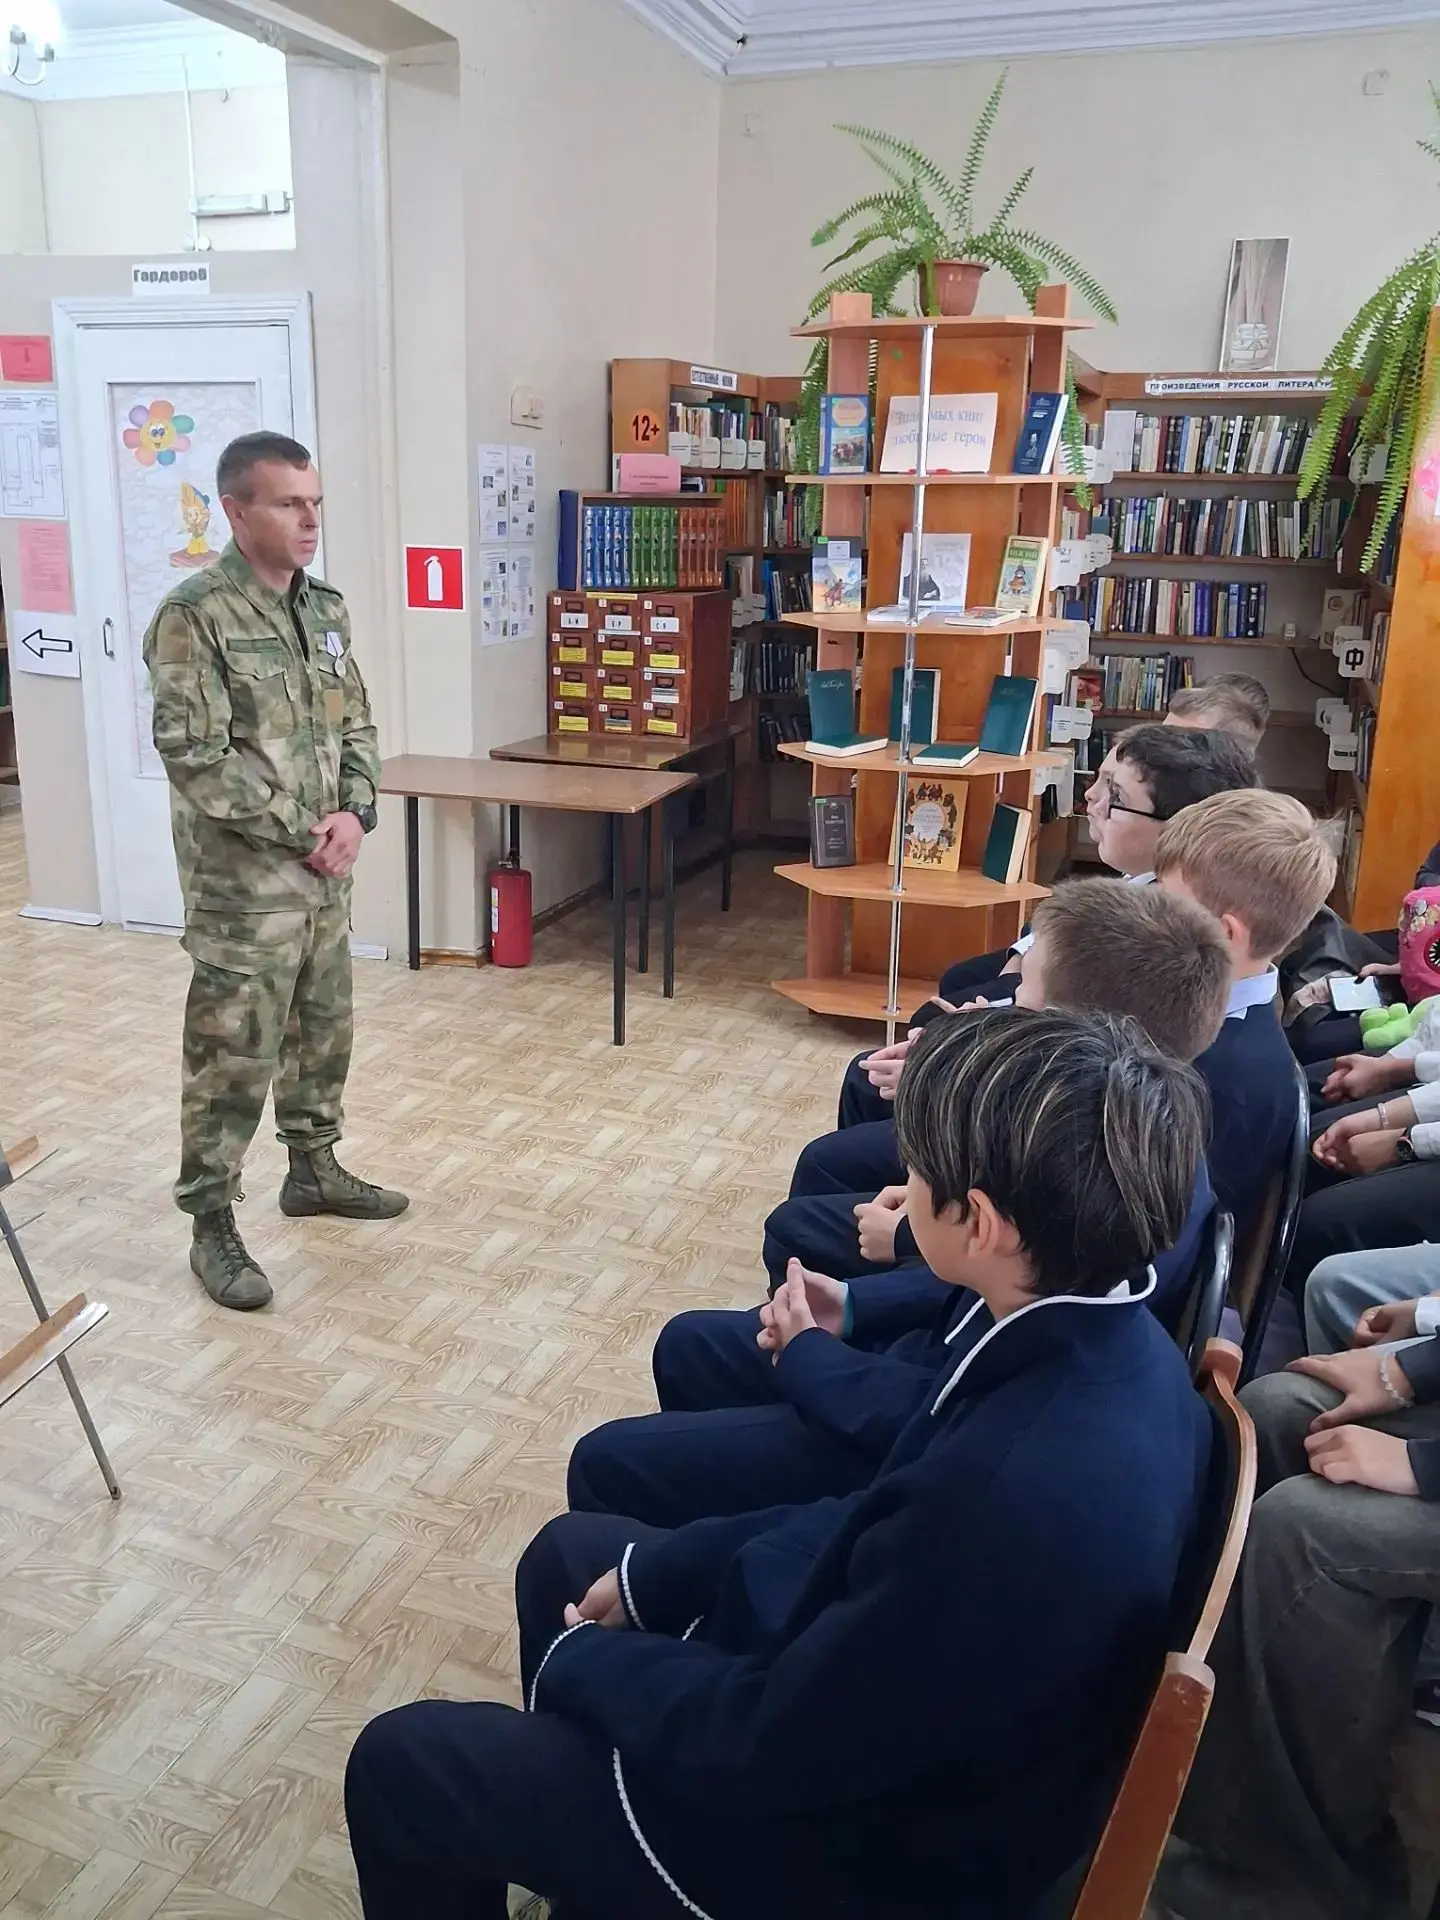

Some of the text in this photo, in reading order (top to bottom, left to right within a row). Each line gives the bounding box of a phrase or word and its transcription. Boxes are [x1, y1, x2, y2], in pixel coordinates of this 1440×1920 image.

[133, 267, 207, 283] Гардероб
[1277, 380, 1332, 389] ЛИТЕРАТУР
[894, 410, 953, 425] Знамых
[632, 415, 660, 441] 12+
[892, 429, 948, 446] любые
[1345, 648, 1365, 671] Ф
